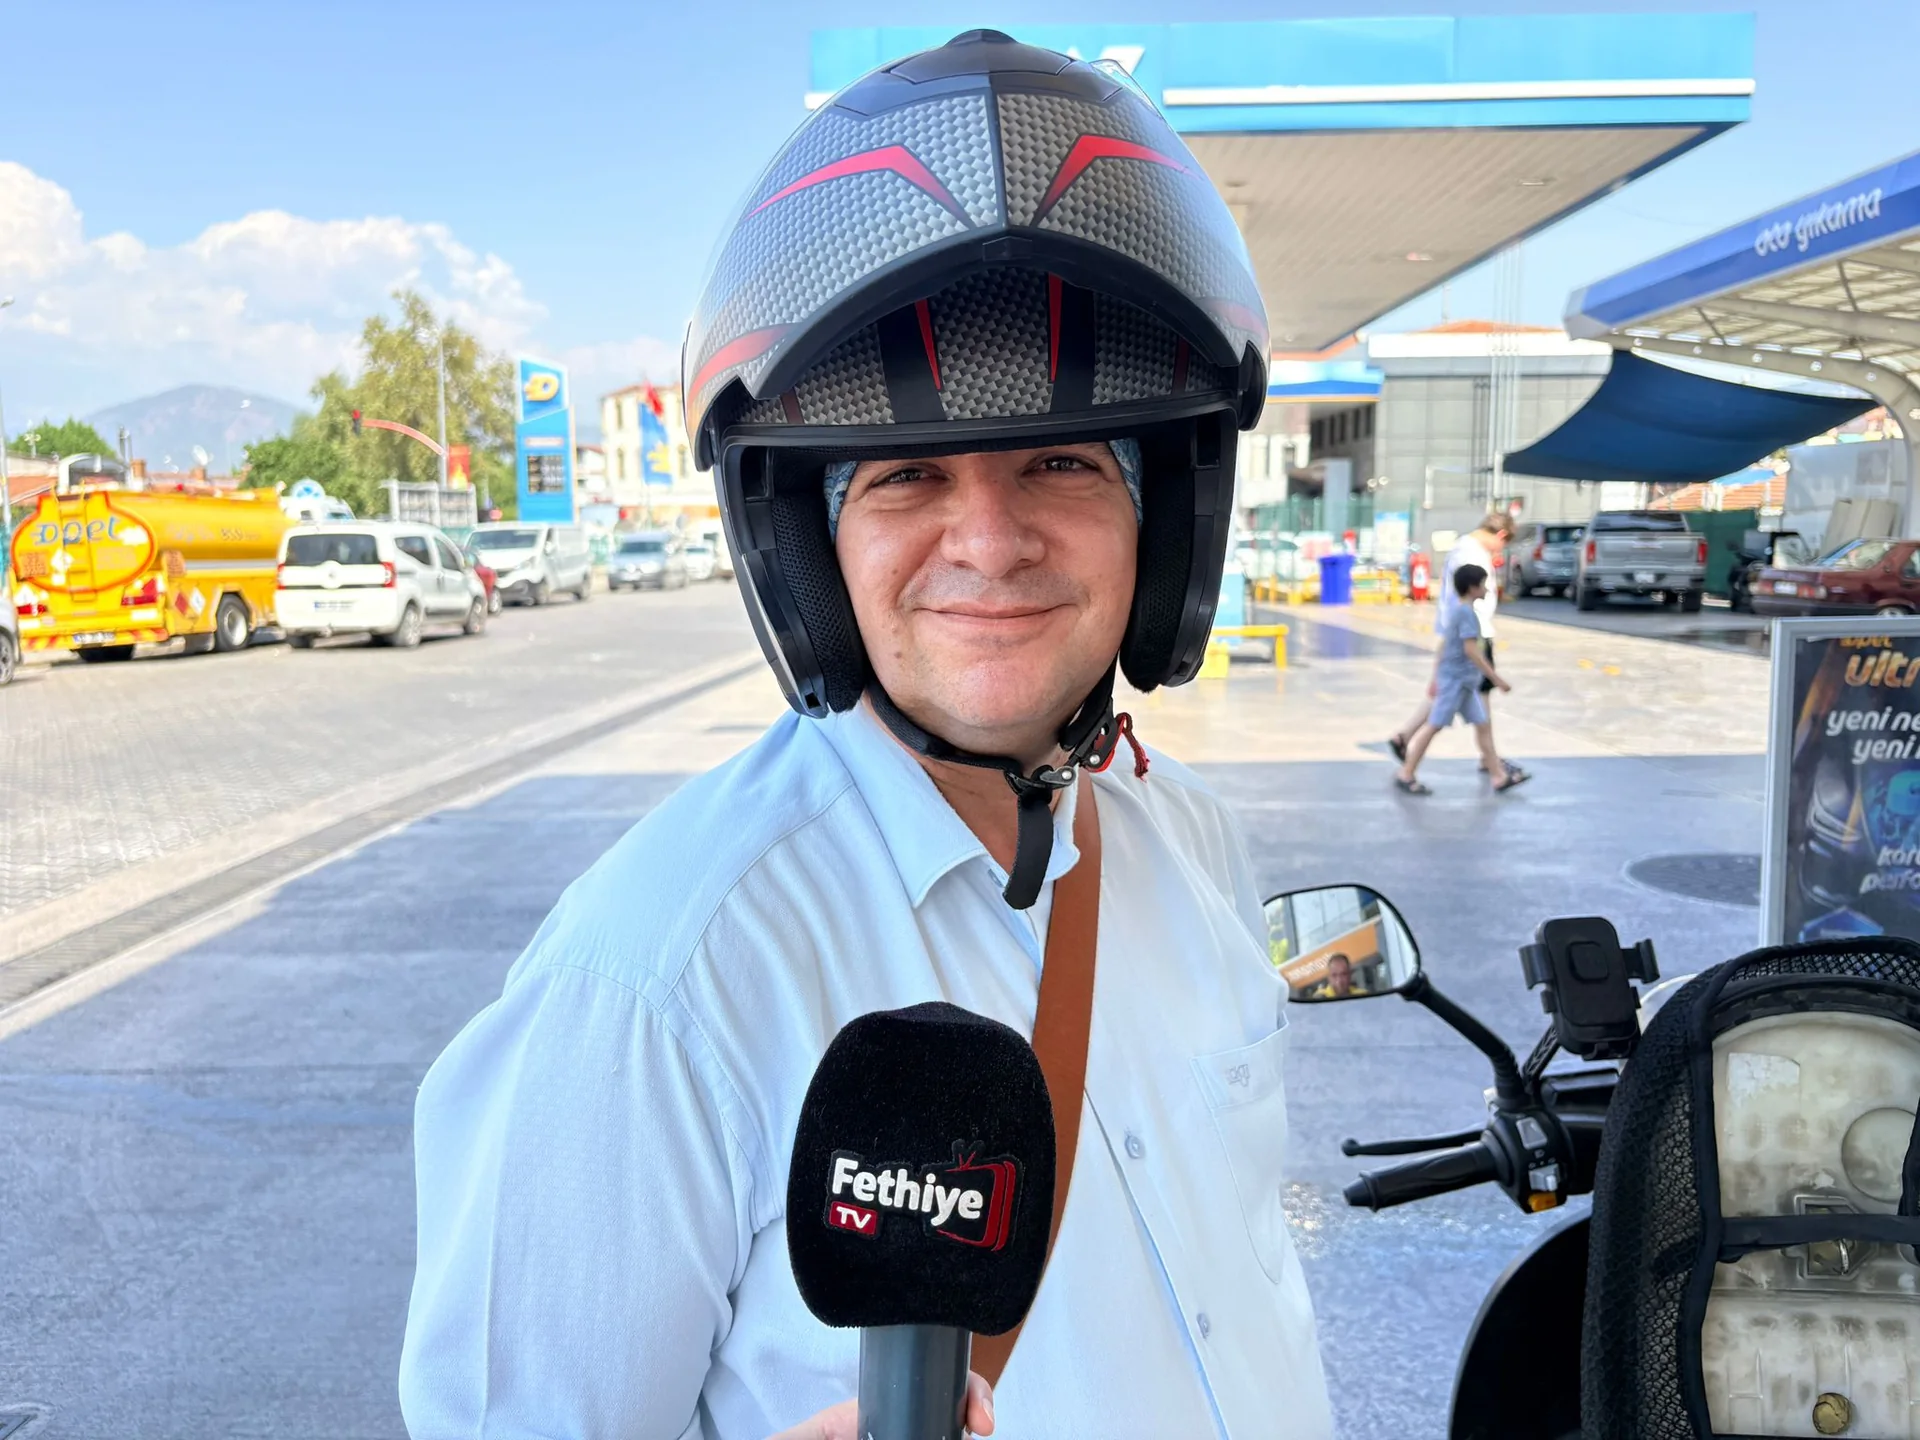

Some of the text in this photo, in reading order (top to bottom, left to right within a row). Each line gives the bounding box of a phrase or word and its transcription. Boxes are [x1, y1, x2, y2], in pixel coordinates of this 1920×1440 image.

[1755, 220, 1793, 257] oto
[1825, 706, 1893, 736] yeni
[1851, 735, 1917, 765] yeni
[832, 1157, 984, 1226] Fethiye
[836, 1206, 872, 1229] TV
